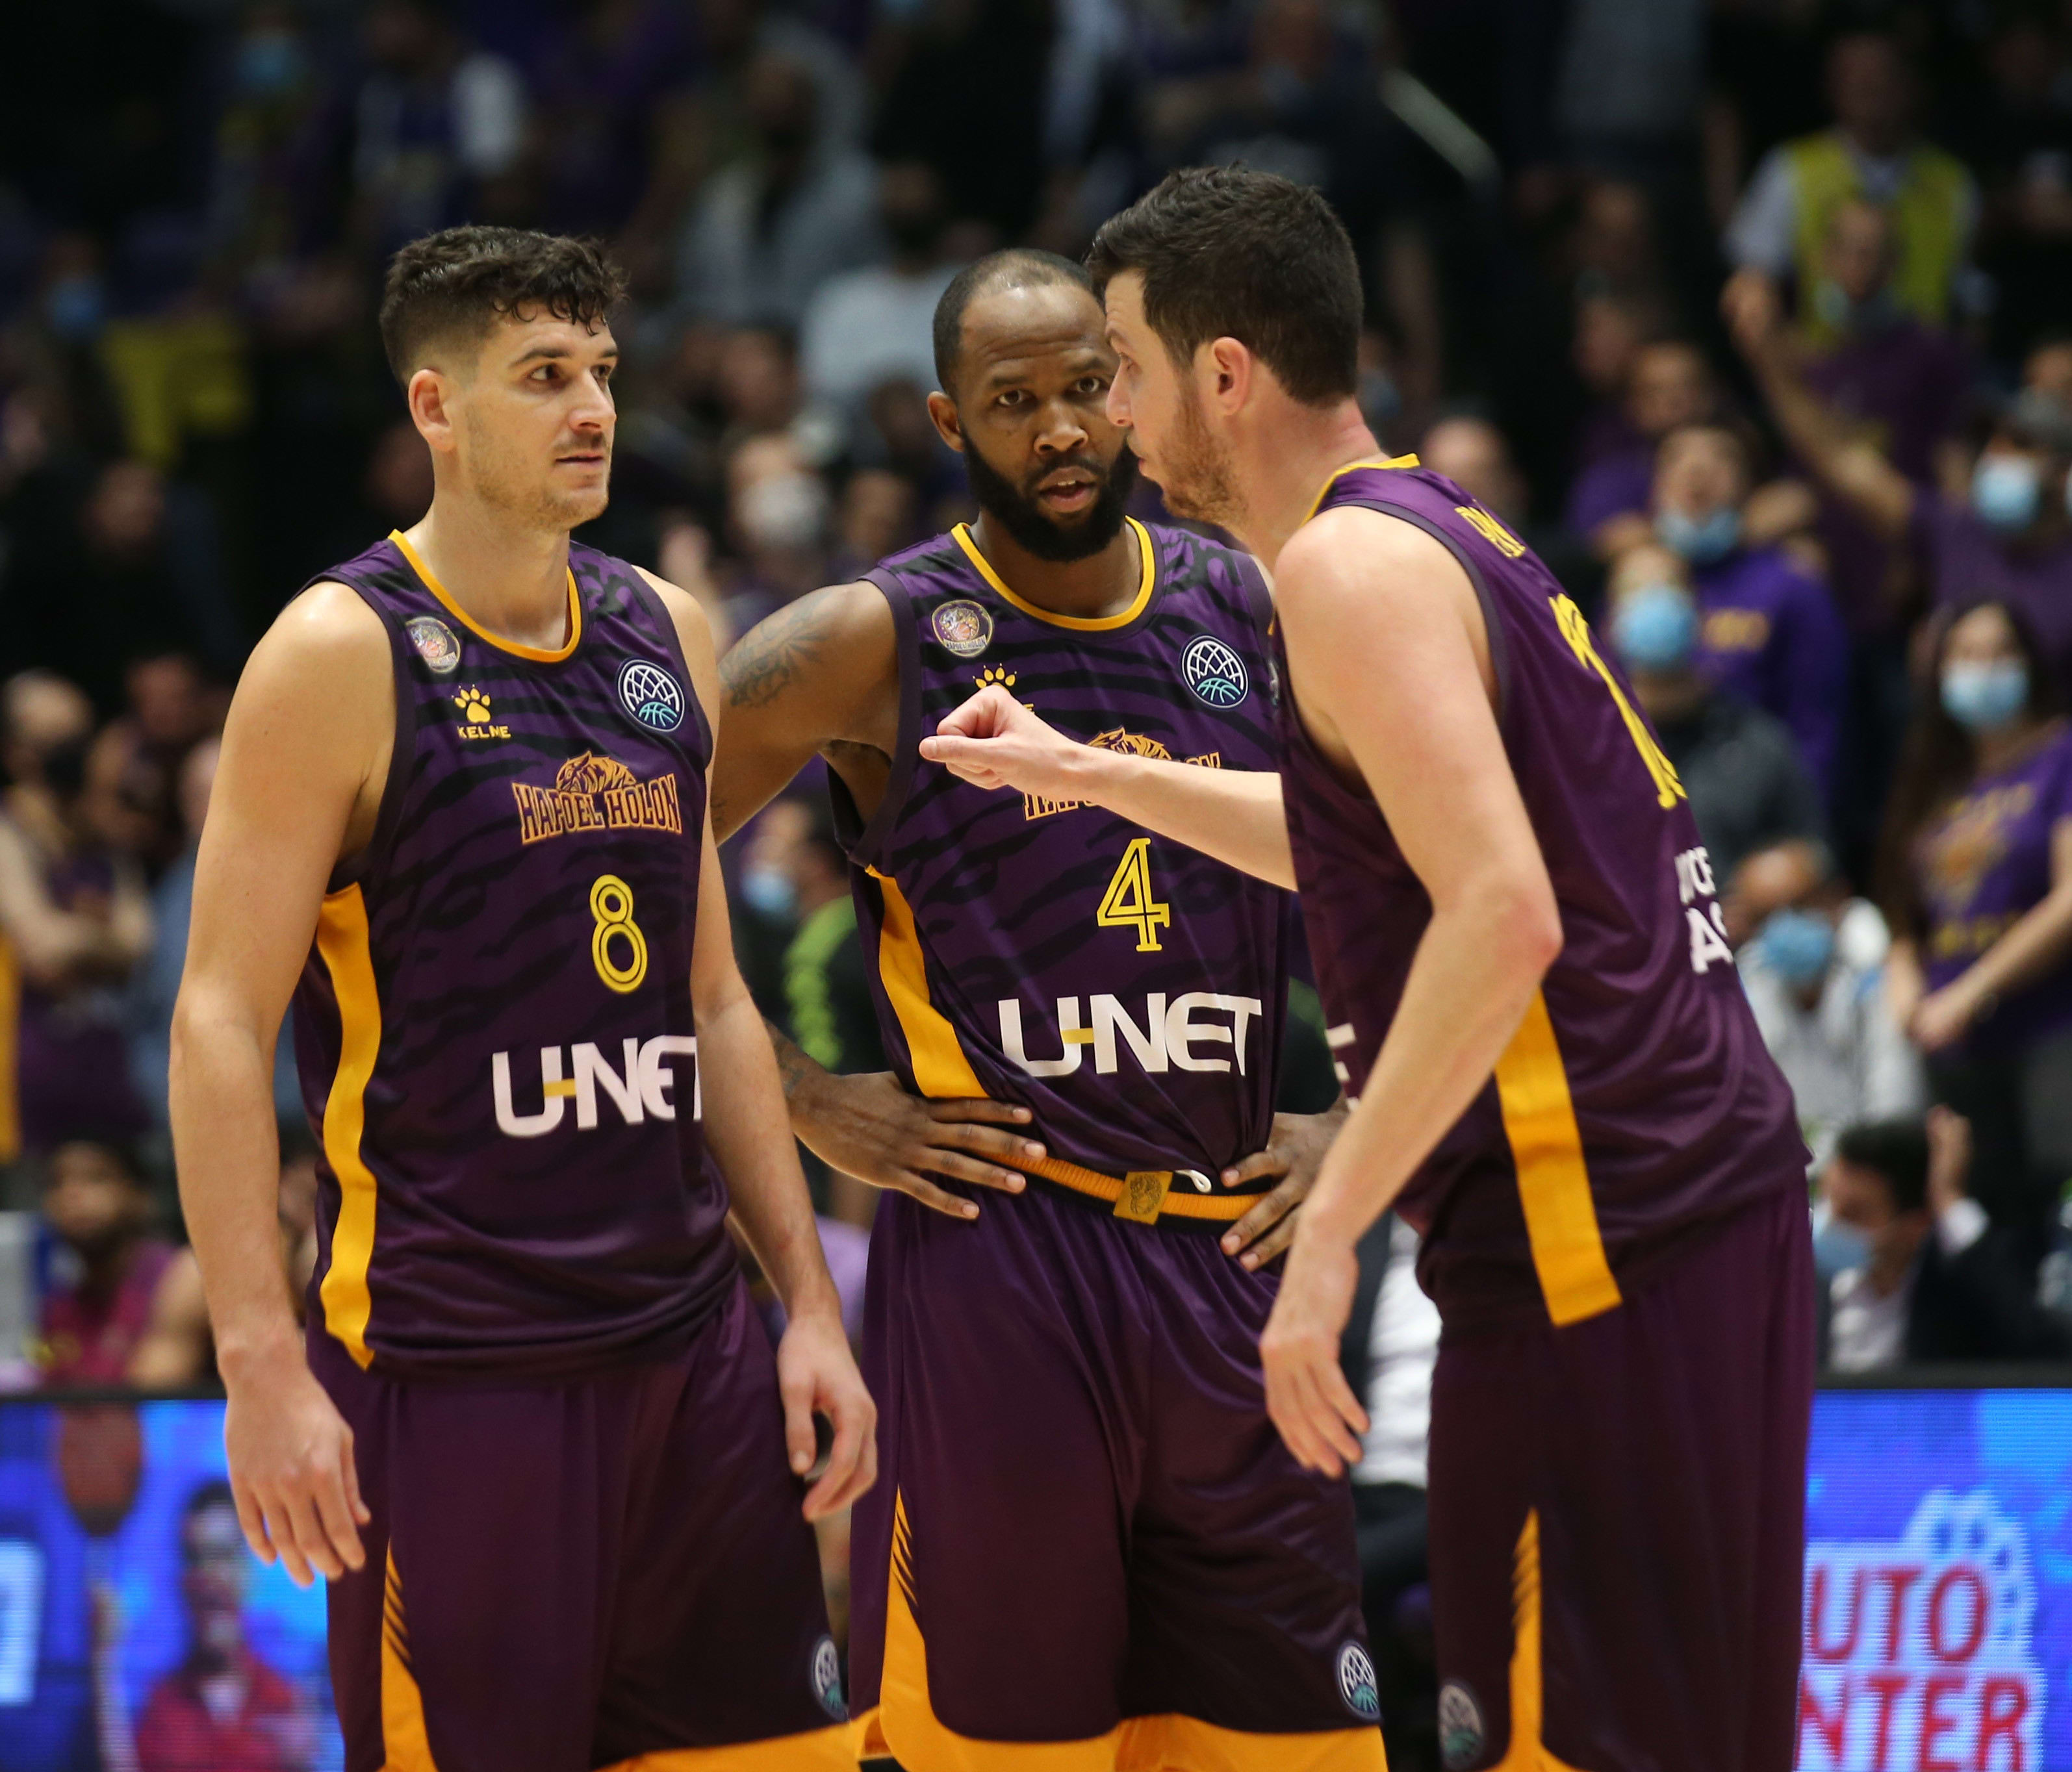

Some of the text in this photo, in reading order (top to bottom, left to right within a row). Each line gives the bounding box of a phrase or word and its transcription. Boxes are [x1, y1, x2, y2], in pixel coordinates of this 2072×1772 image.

[511, 773, 682, 844] HAPOEL HOLON
[589, 874, 648, 995] 8
[1096, 837, 1170, 952] 4
[1808, 1563, 1988, 1663] UTO
[1795, 1674, 2030, 1772] NTER
